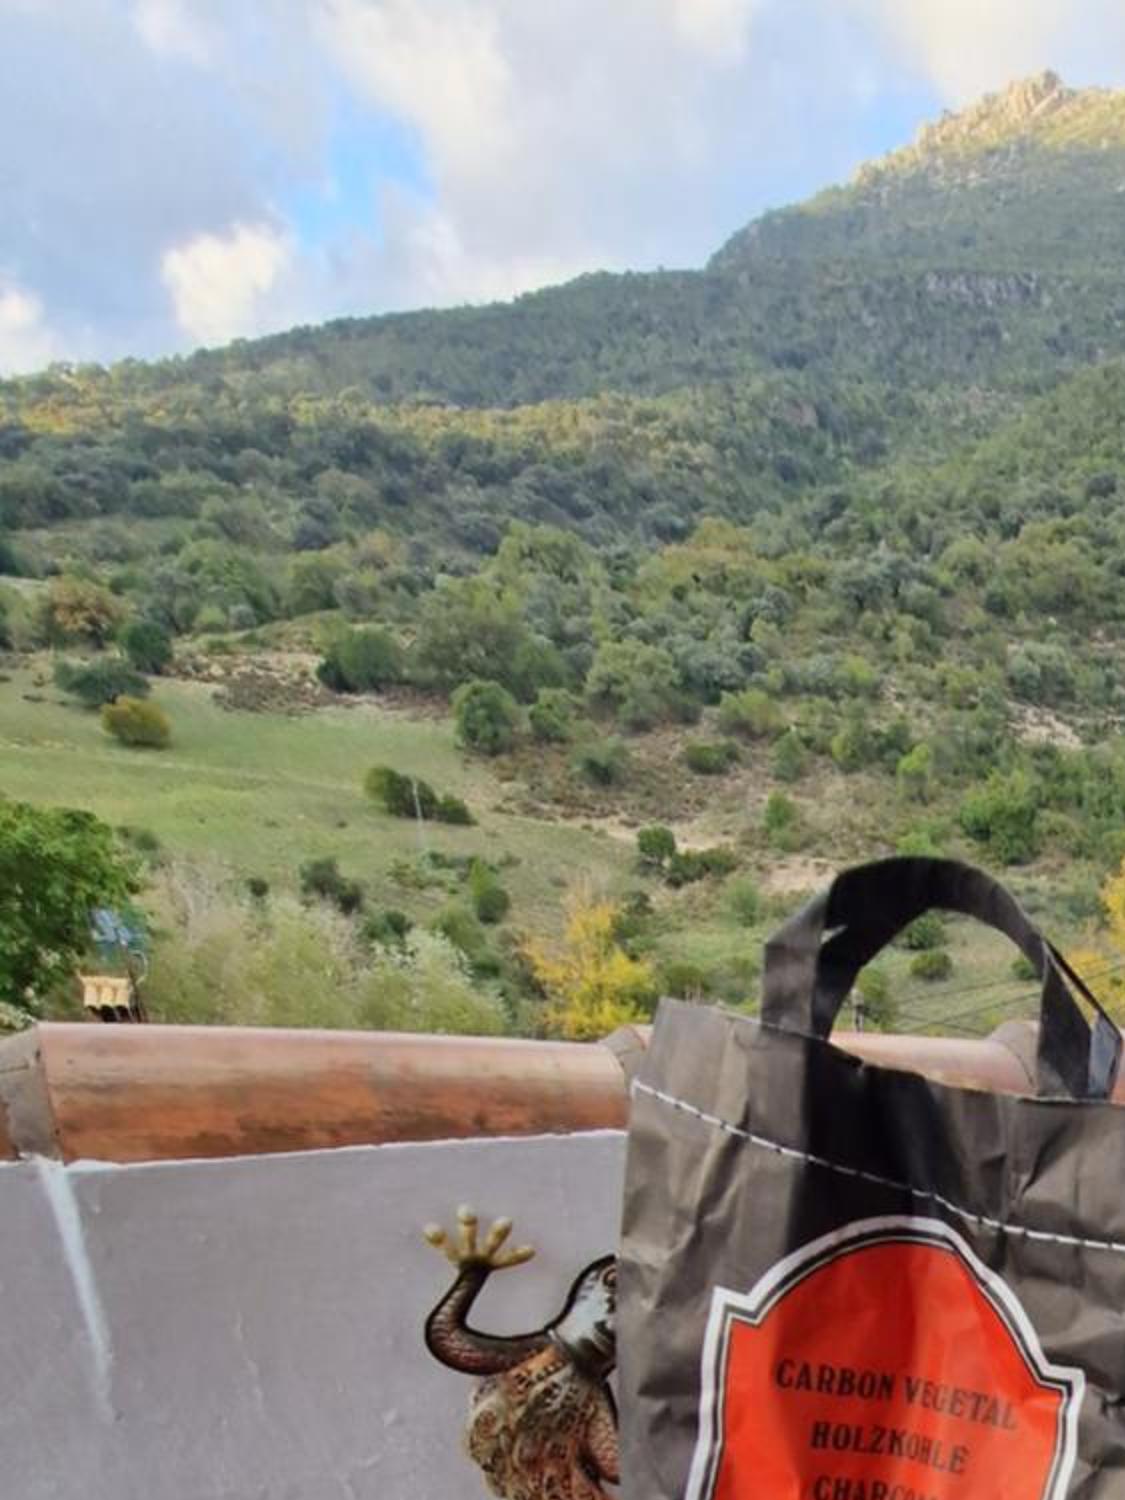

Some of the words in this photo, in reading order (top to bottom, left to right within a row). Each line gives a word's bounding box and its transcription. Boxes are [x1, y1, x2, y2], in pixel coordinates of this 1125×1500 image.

[773, 1358, 896, 1400] CARBON
[904, 1376, 1018, 1431] VEGETAL
[810, 1420, 970, 1474] HOLZKOHLE
